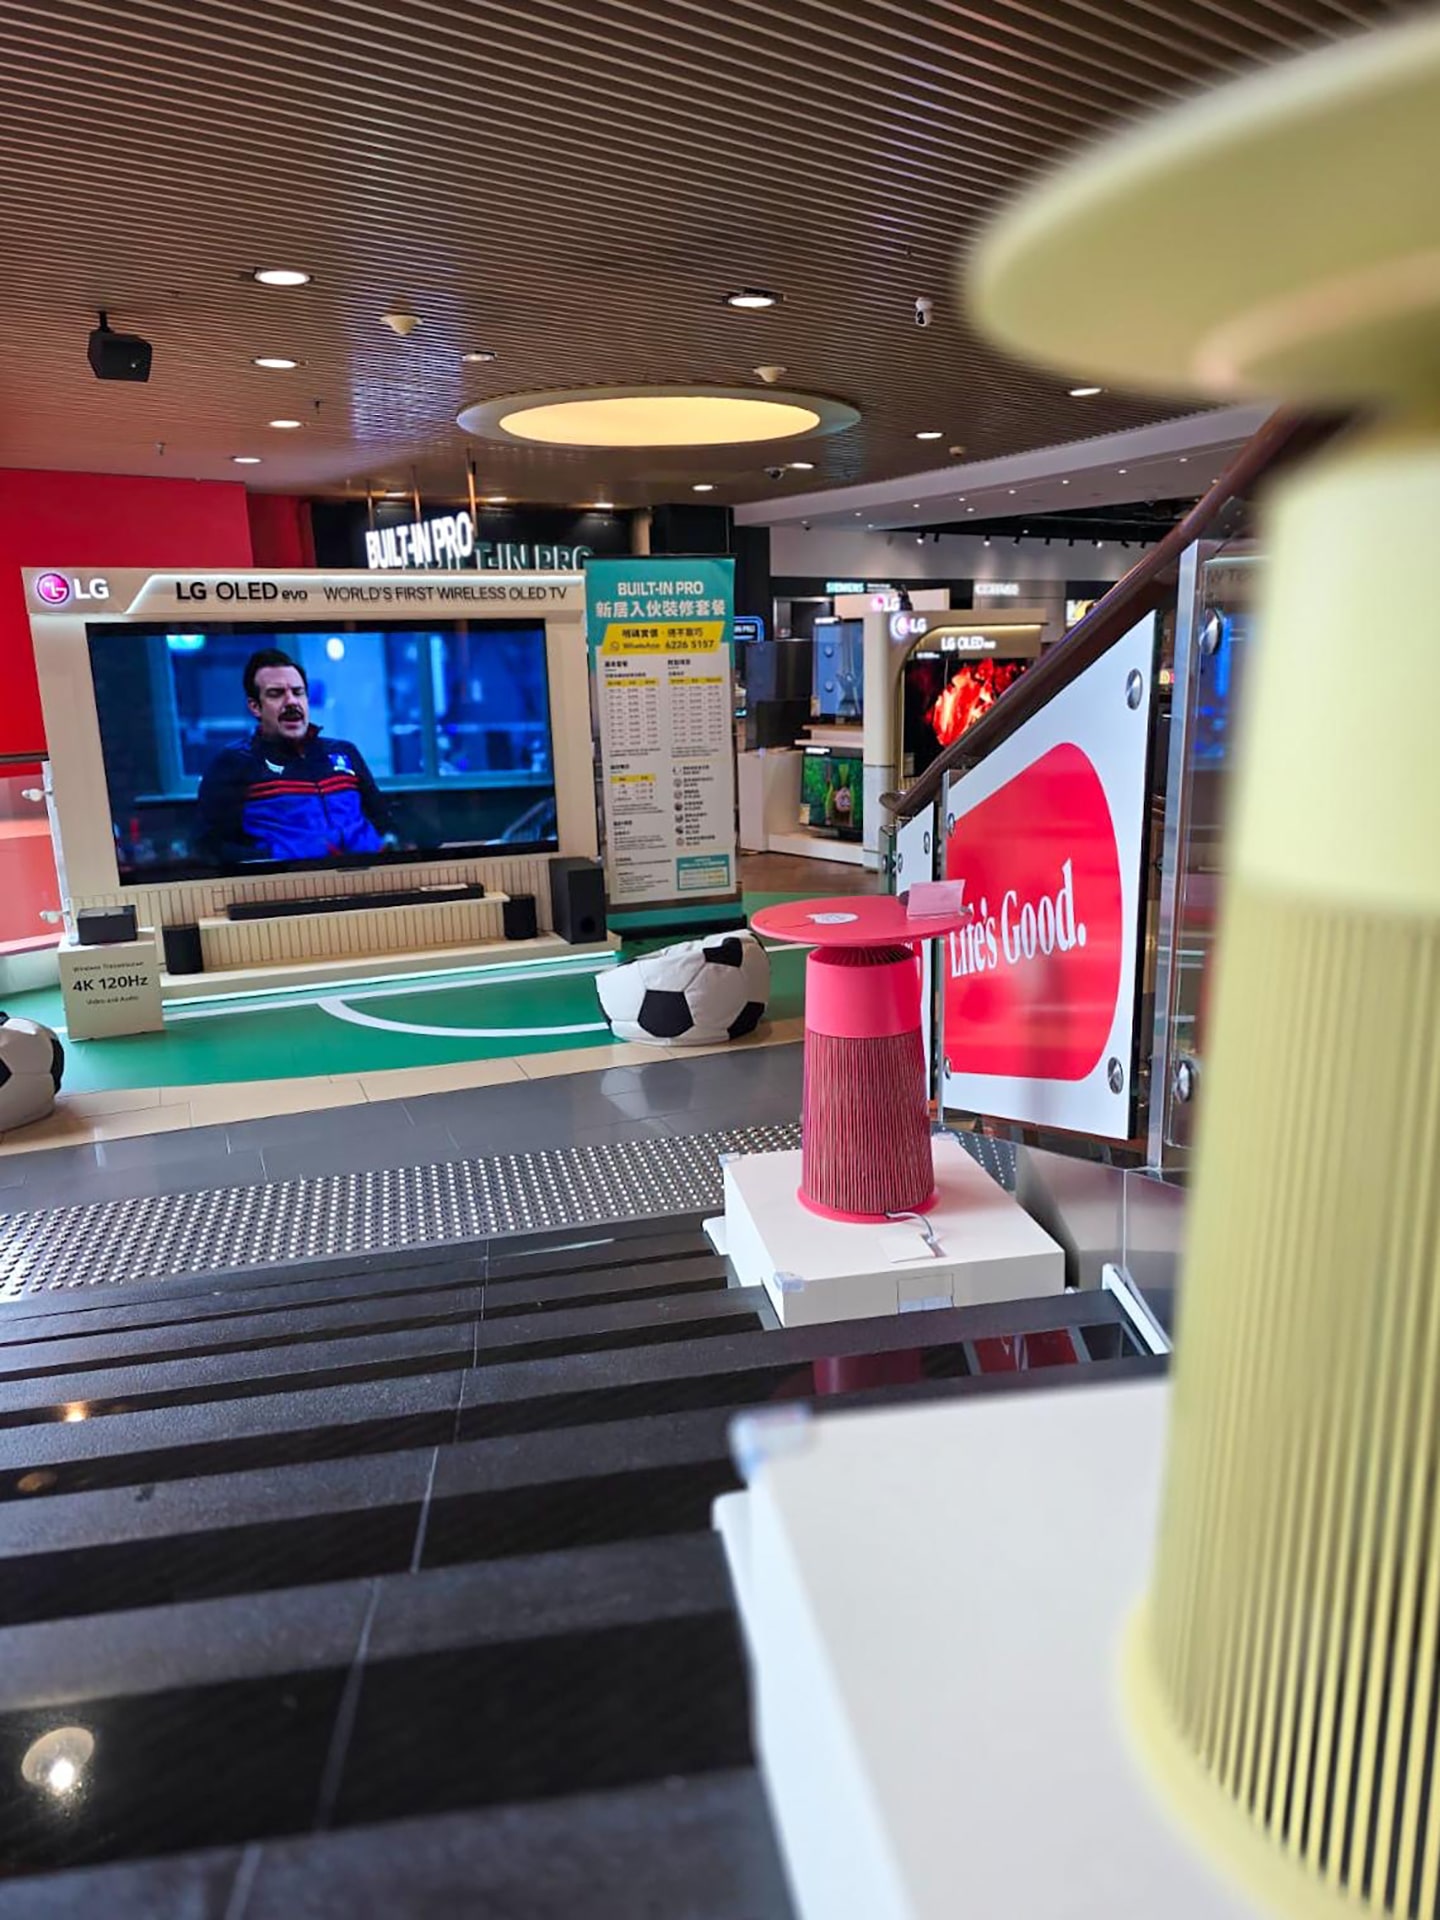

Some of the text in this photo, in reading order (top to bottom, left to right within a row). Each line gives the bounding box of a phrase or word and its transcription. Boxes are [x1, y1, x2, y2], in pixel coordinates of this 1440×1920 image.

[366, 511, 474, 569] BUILT-IN PRO
[73, 578, 109, 600] LG
[176, 581, 308, 601] LG OLED evo
[323, 586, 567, 601] WORLD'S FIRST WIRELESS OLED TV
[617, 581, 704, 596] BUILT-IN PRO
[595, 599, 726, 618] 新居入伙裝修套餐
[883, 599, 900, 611] LG
[910, 618, 927, 633] LG
[941, 636, 956, 650] LG
[957, 636, 984, 650] OLED
[1001, 857, 1087, 964] Good.
[72, 974, 149, 991] 4K 120Hz
